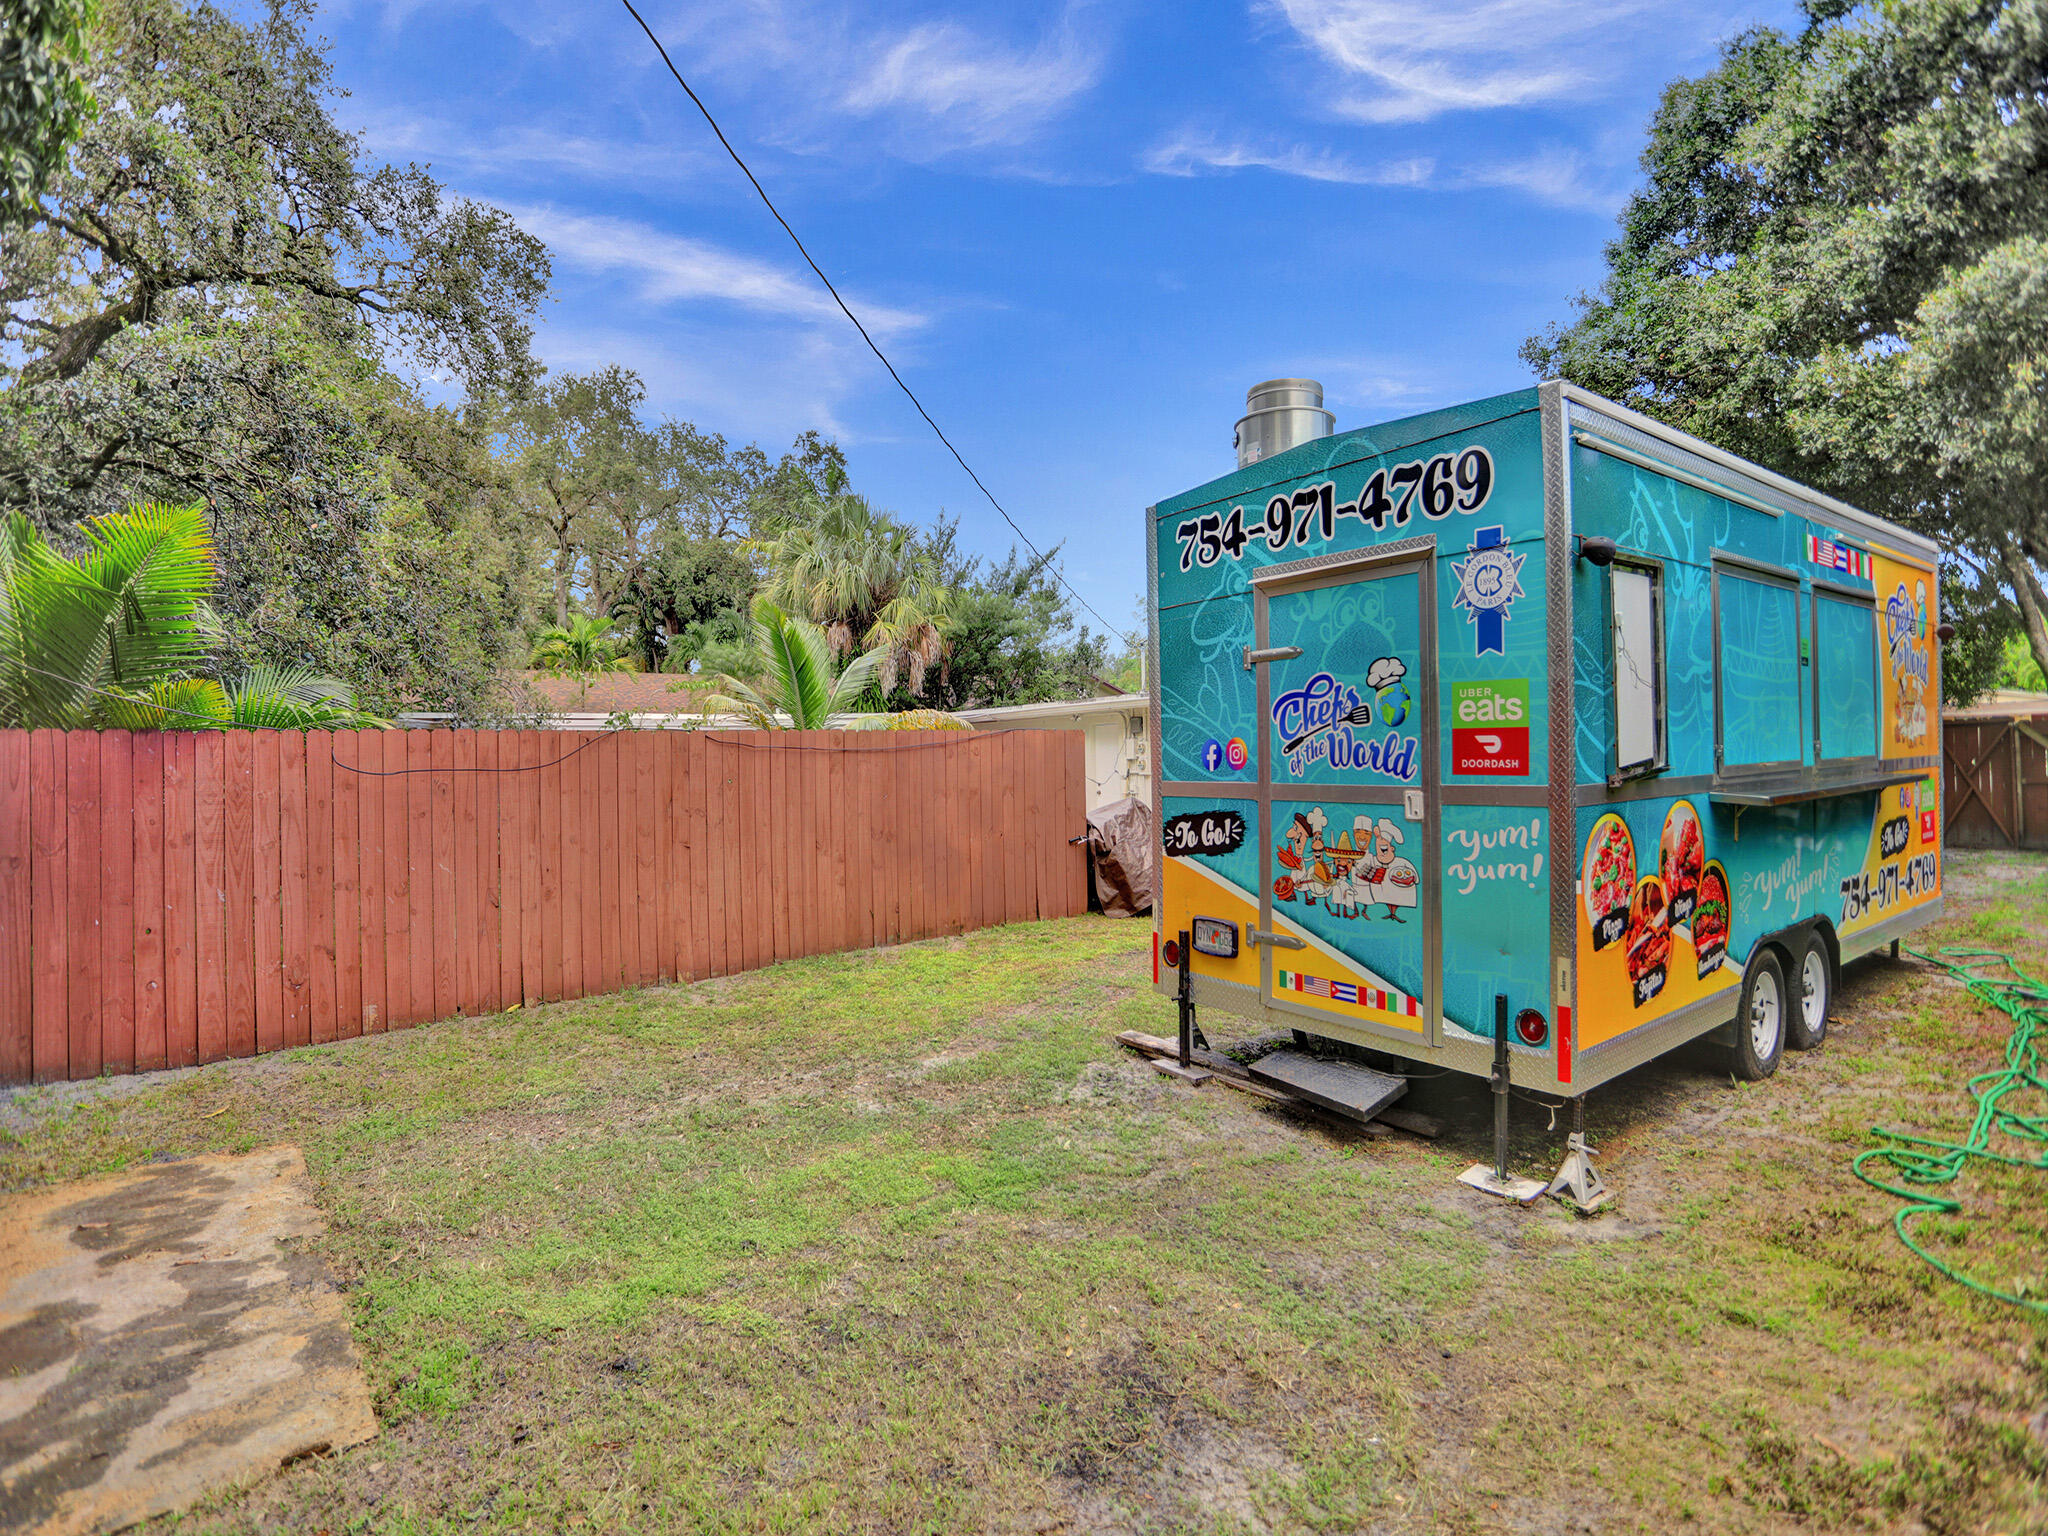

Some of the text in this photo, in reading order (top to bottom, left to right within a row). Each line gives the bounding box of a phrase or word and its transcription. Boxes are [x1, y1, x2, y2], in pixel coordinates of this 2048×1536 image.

[1176, 446, 1493, 571] 754-971-4769
[1468, 553, 1503, 578] CORDON
[1502, 561, 1513, 588] BLEU
[1476, 596, 1503, 606] PARIS
[1458, 693, 1523, 722] eats
[1459, 687, 1492, 698] UBER
[1290, 726, 1417, 780] of the World
[1461, 758, 1520, 769] DOORDASH
[1175, 818, 1231, 849] To Go!
[1840, 852, 1936, 923] 754-971-4769
[1602, 918, 1623, 942] Pizza
